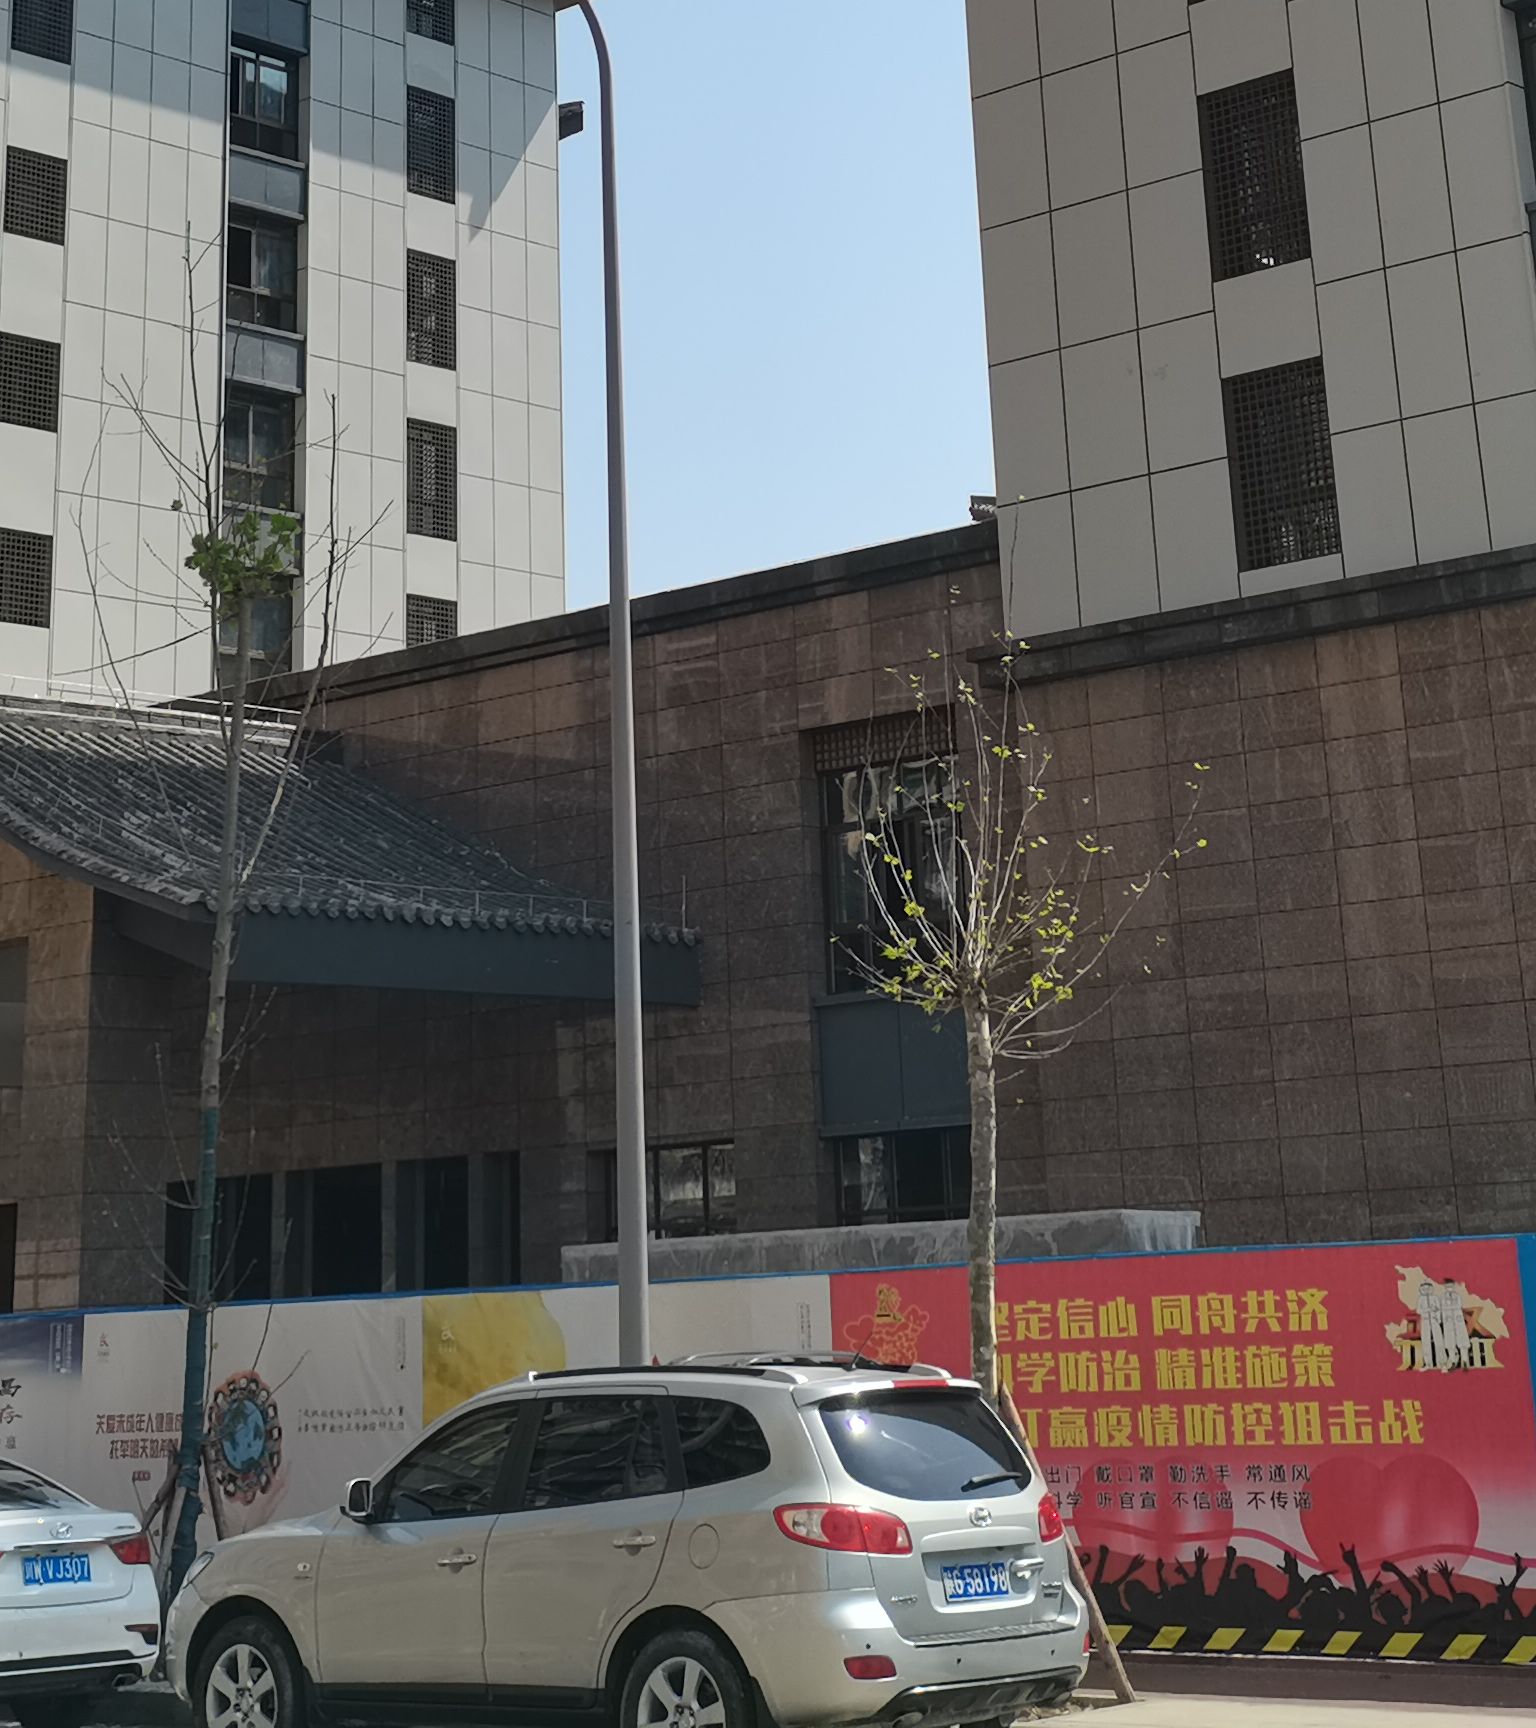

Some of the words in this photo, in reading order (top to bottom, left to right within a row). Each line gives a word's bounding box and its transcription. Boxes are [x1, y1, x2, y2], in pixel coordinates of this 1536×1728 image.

[1151, 1288, 1329, 1337] 同舟共济
[1154, 1343, 1336, 1391] 精准施策
[1095, 1465, 1155, 1485] 戴口罩
[1169, 1464, 1232, 1484] 勤洗手
[1245, 1463, 1311, 1484] 常通风
[1096, 1491, 1158, 1511] 听官宣
[1171, 1490, 1234, 1511] 不信谣
[1246, 1489, 1313, 1511] 不传谣
